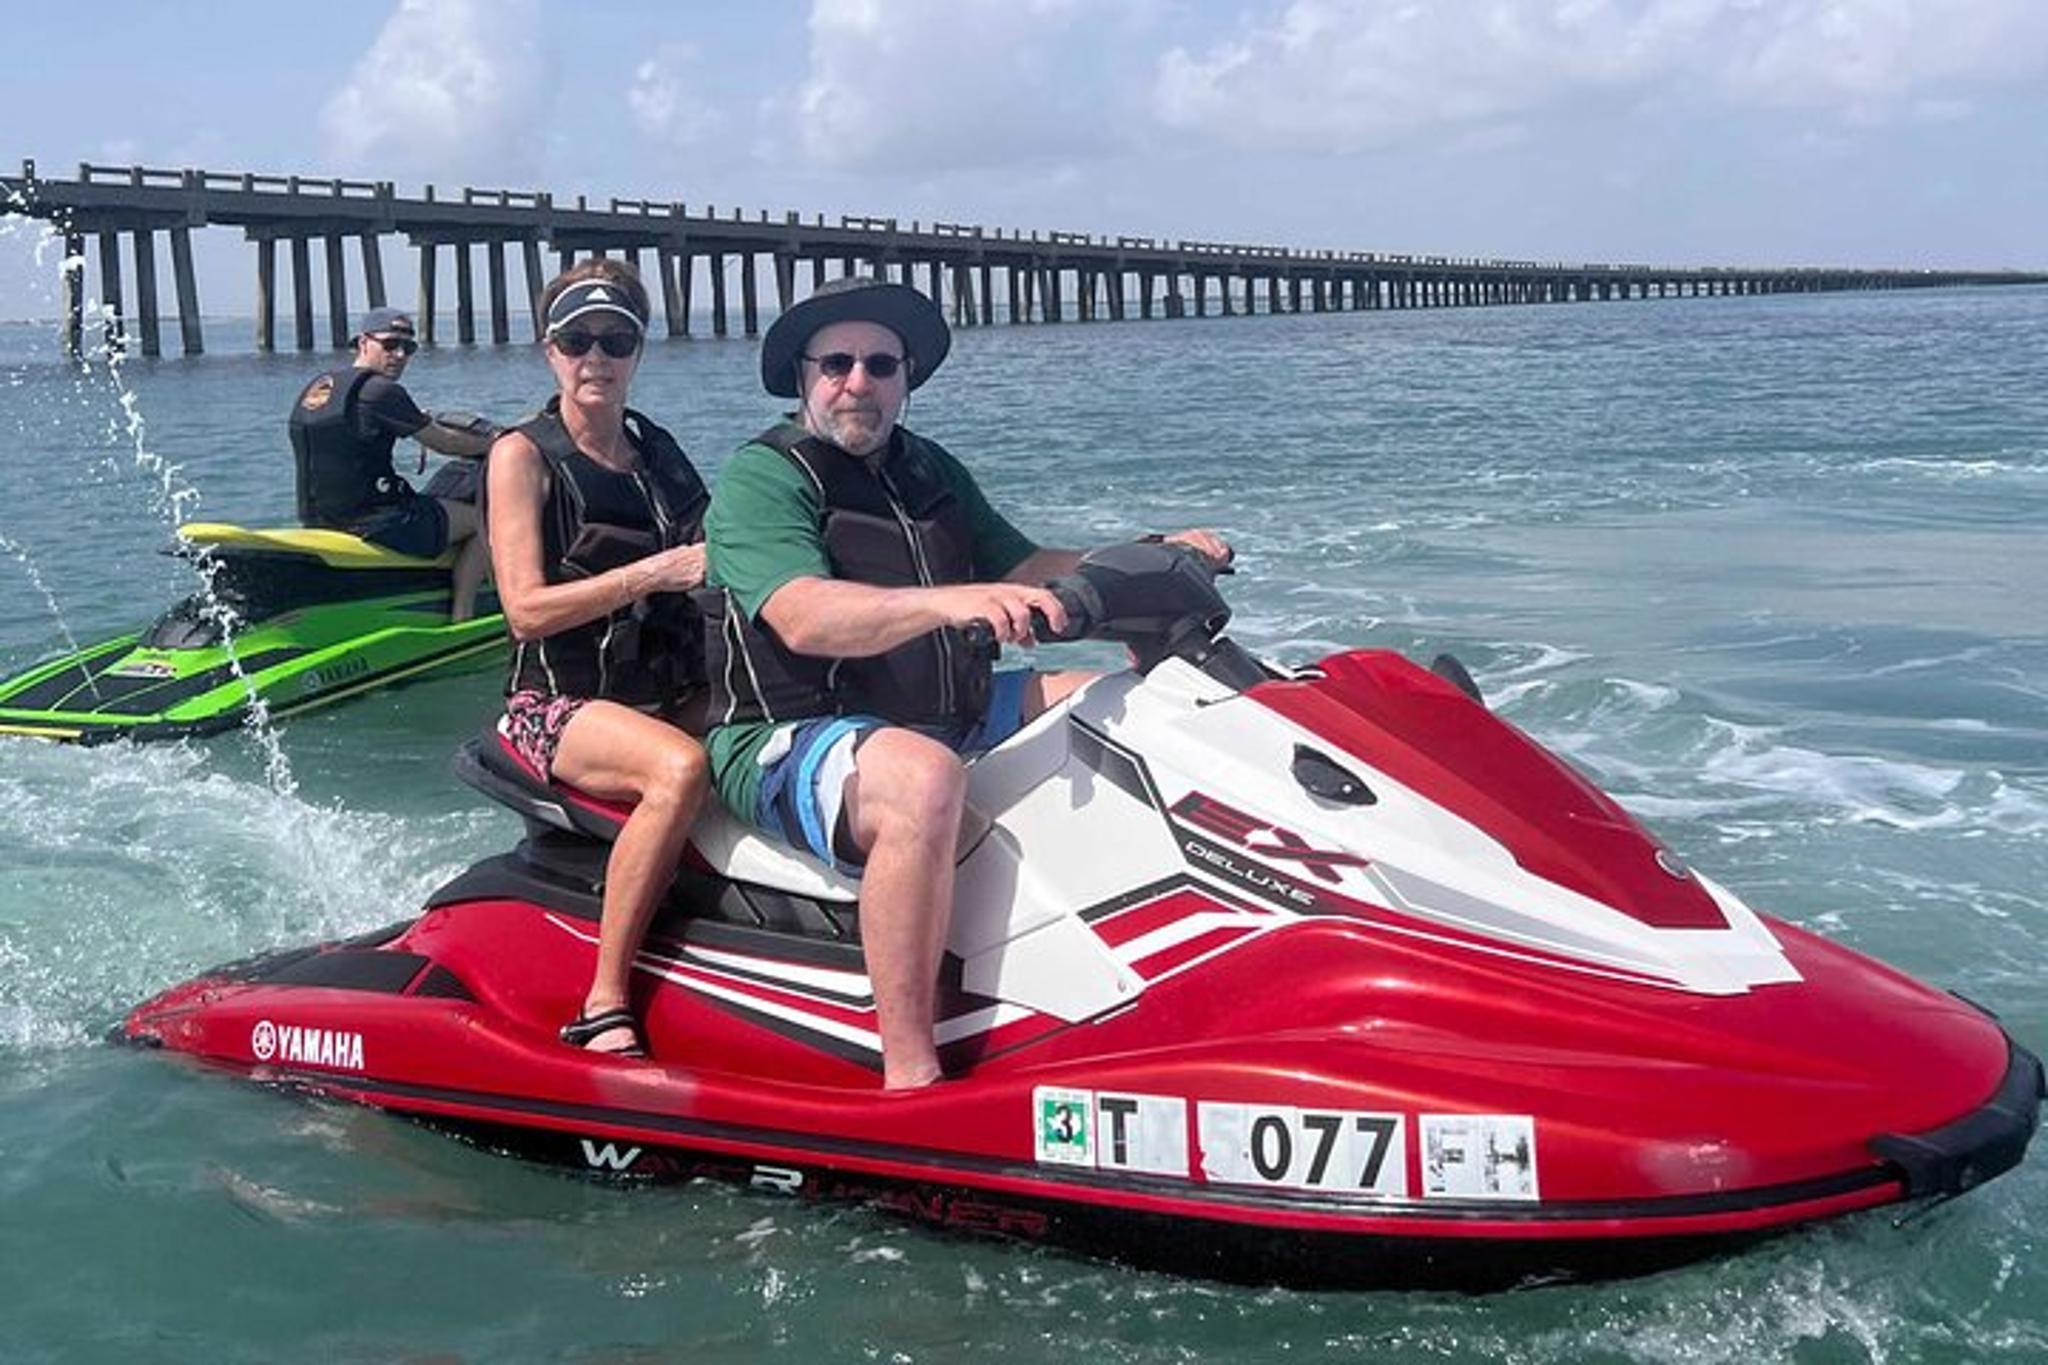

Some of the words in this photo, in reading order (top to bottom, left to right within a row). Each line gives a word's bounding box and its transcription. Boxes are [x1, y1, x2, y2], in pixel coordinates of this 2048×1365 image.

[1168, 790, 1371, 884] EX
[1185, 841, 1316, 906] DELUXE
[278, 1024, 365, 1070] YAMAHA
[1055, 1104, 1074, 1144] 3
[1100, 1097, 1138, 1166] T
[1250, 1114, 1398, 1188] 077
